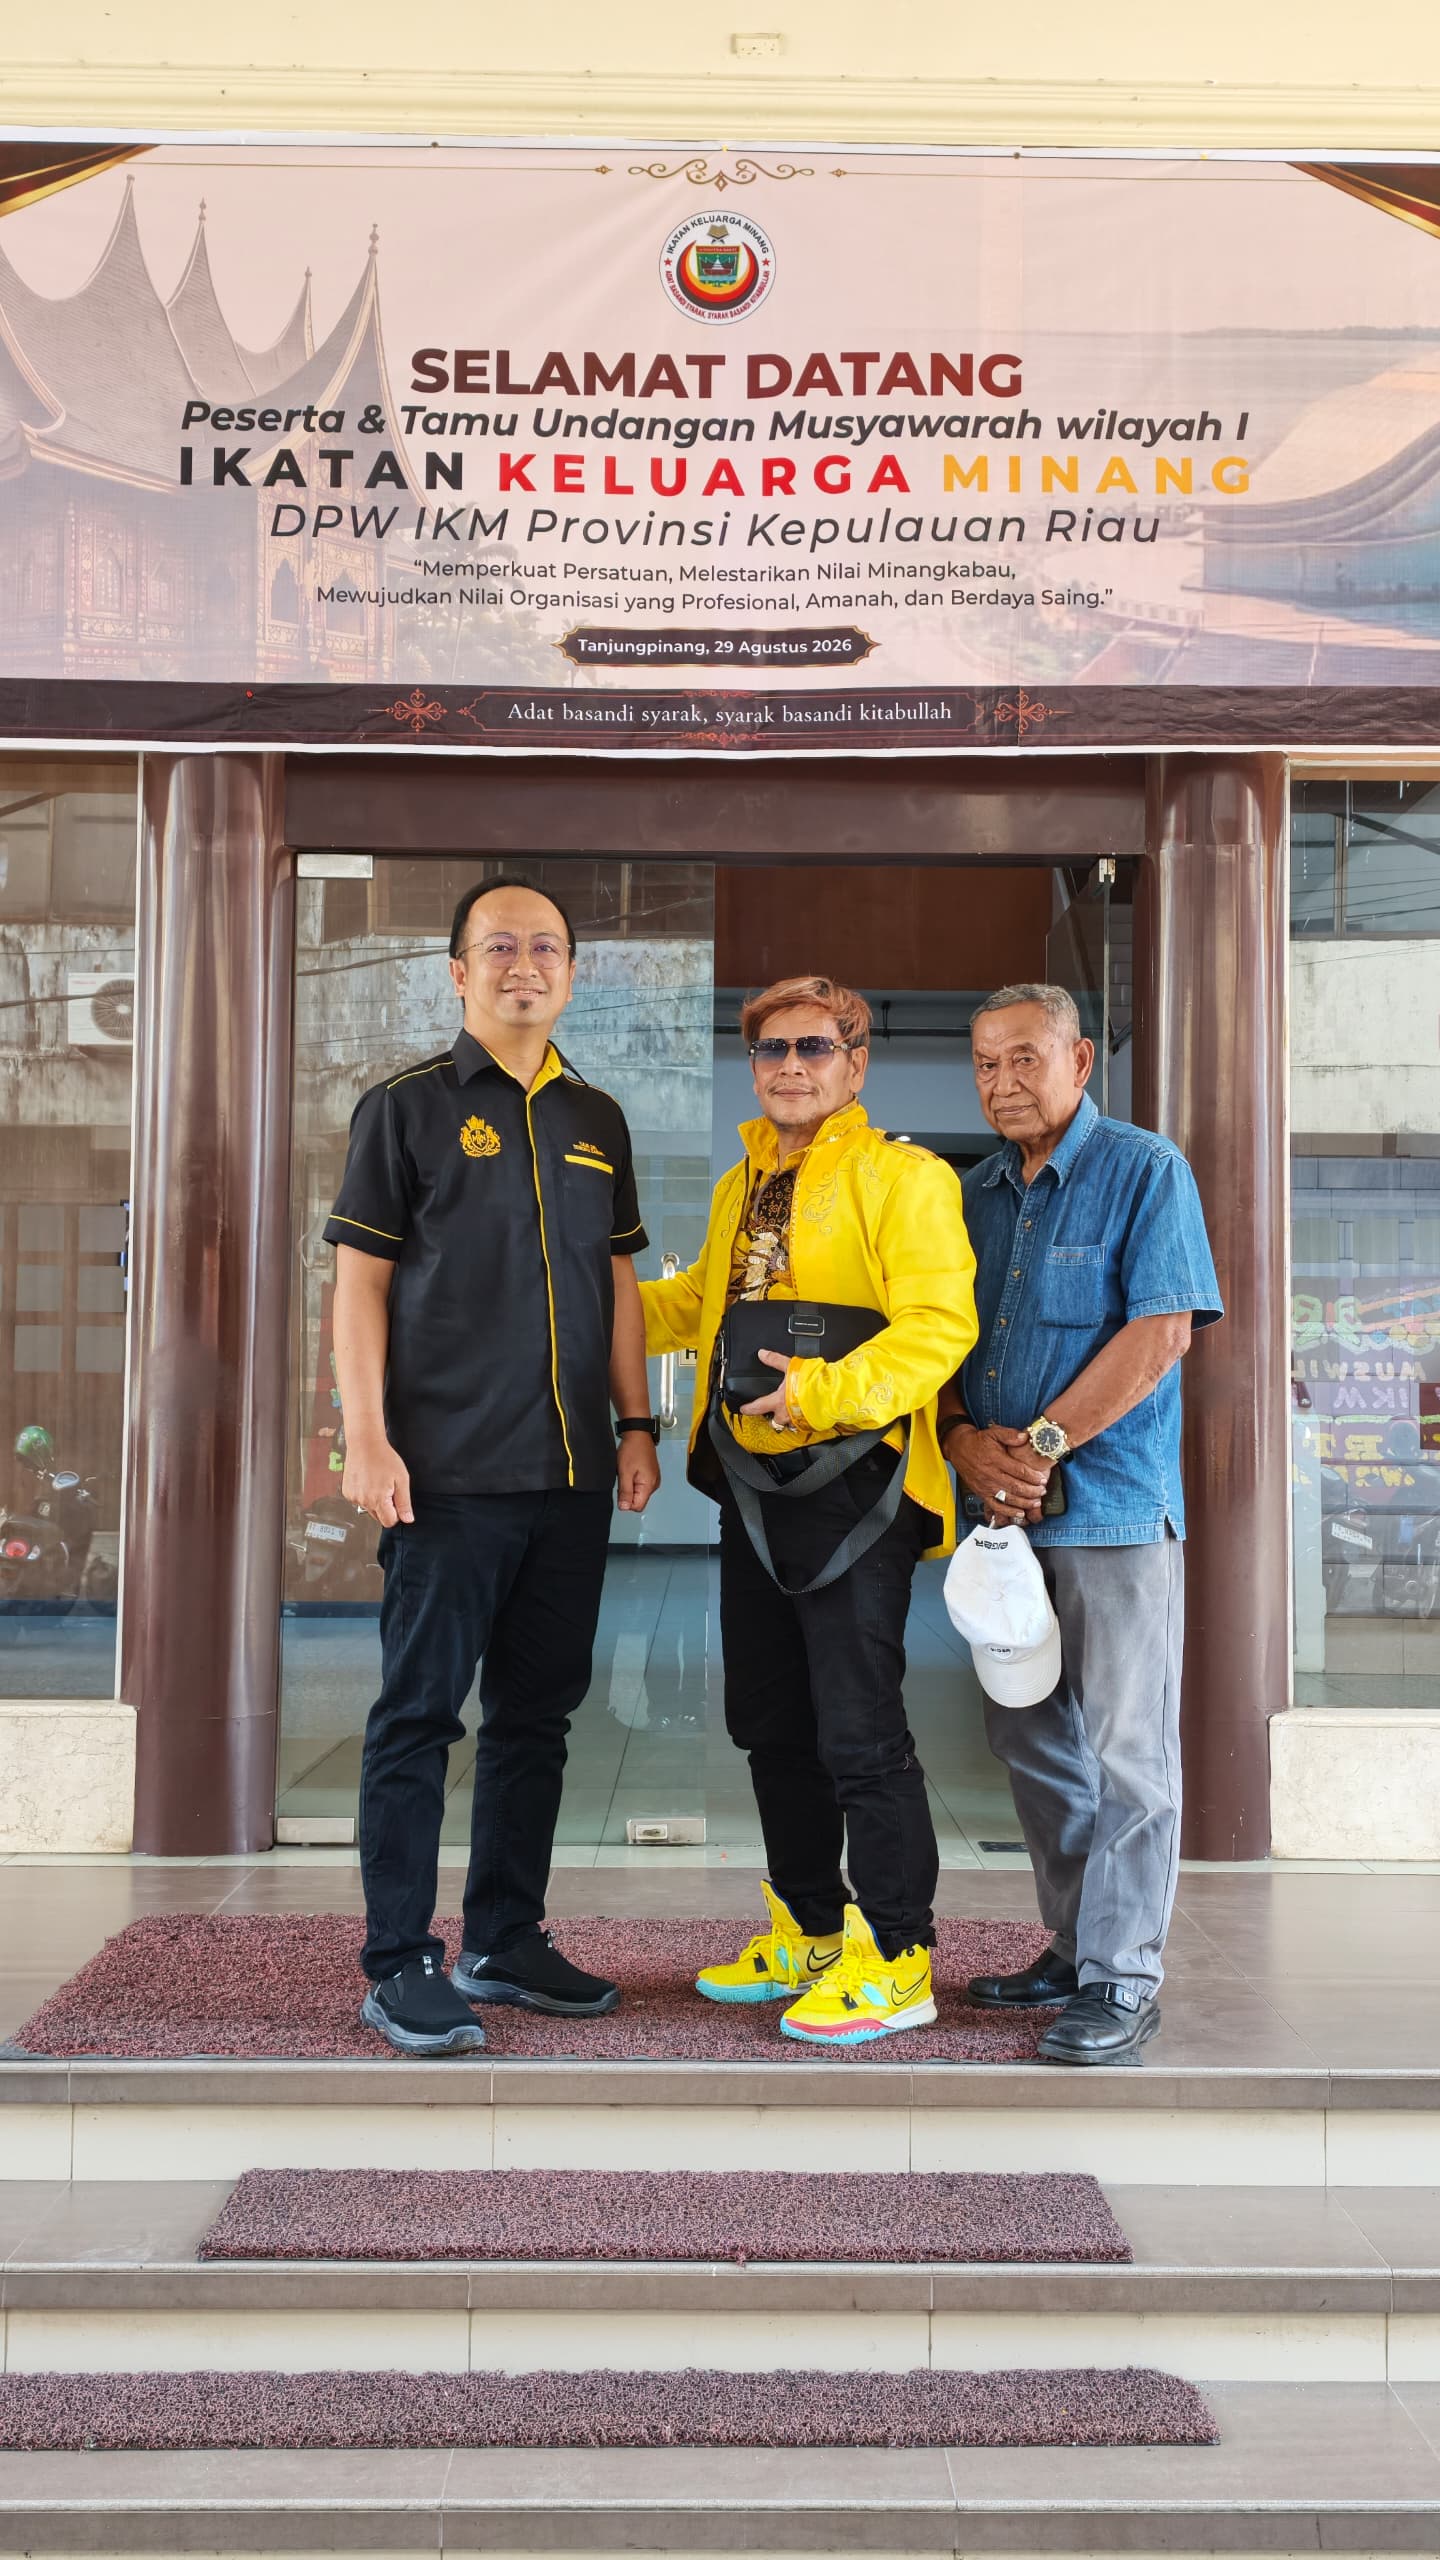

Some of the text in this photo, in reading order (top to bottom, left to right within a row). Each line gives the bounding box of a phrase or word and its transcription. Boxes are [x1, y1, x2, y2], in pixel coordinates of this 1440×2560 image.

[667, 215, 769, 254] IKATAN KELUARGA MINANG
[410, 348, 1023, 400] SELAMAT DATANG
[181, 401, 1249, 449] Peserta & Tamu Undangan Musyawarah wilayah I
[180, 446, 1250, 497] IKATAN KELUARGA MINANG
[270, 503, 1160, 553] DPW IKM Provinsi Kepulauan Riau
[413, 559, 1016, 585] “Memperkuat Persatuan, Melestarikan Nilai Minangkabau,
[317, 586, 452, 608] Mewujudkan
[459, 588, 503, 605] Nilai
[510, 590, 618, 610] Organisasi
[625, 597, 675, 613] yang
[682, 593, 800, 612] Profesional,
[806, 590, 898, 609] Amanah,
[904, 589, 943, 606] dan
[951, 589, 1035, 610] Berdaya
[577, 638, 852, 656] Tanjungpinang, 29 Agustus 2026
[507, 701, 952, 727] Adat basandi syarak, syarak basandi kitabullah
[974, 1538, 1009, 1550] EIGER
